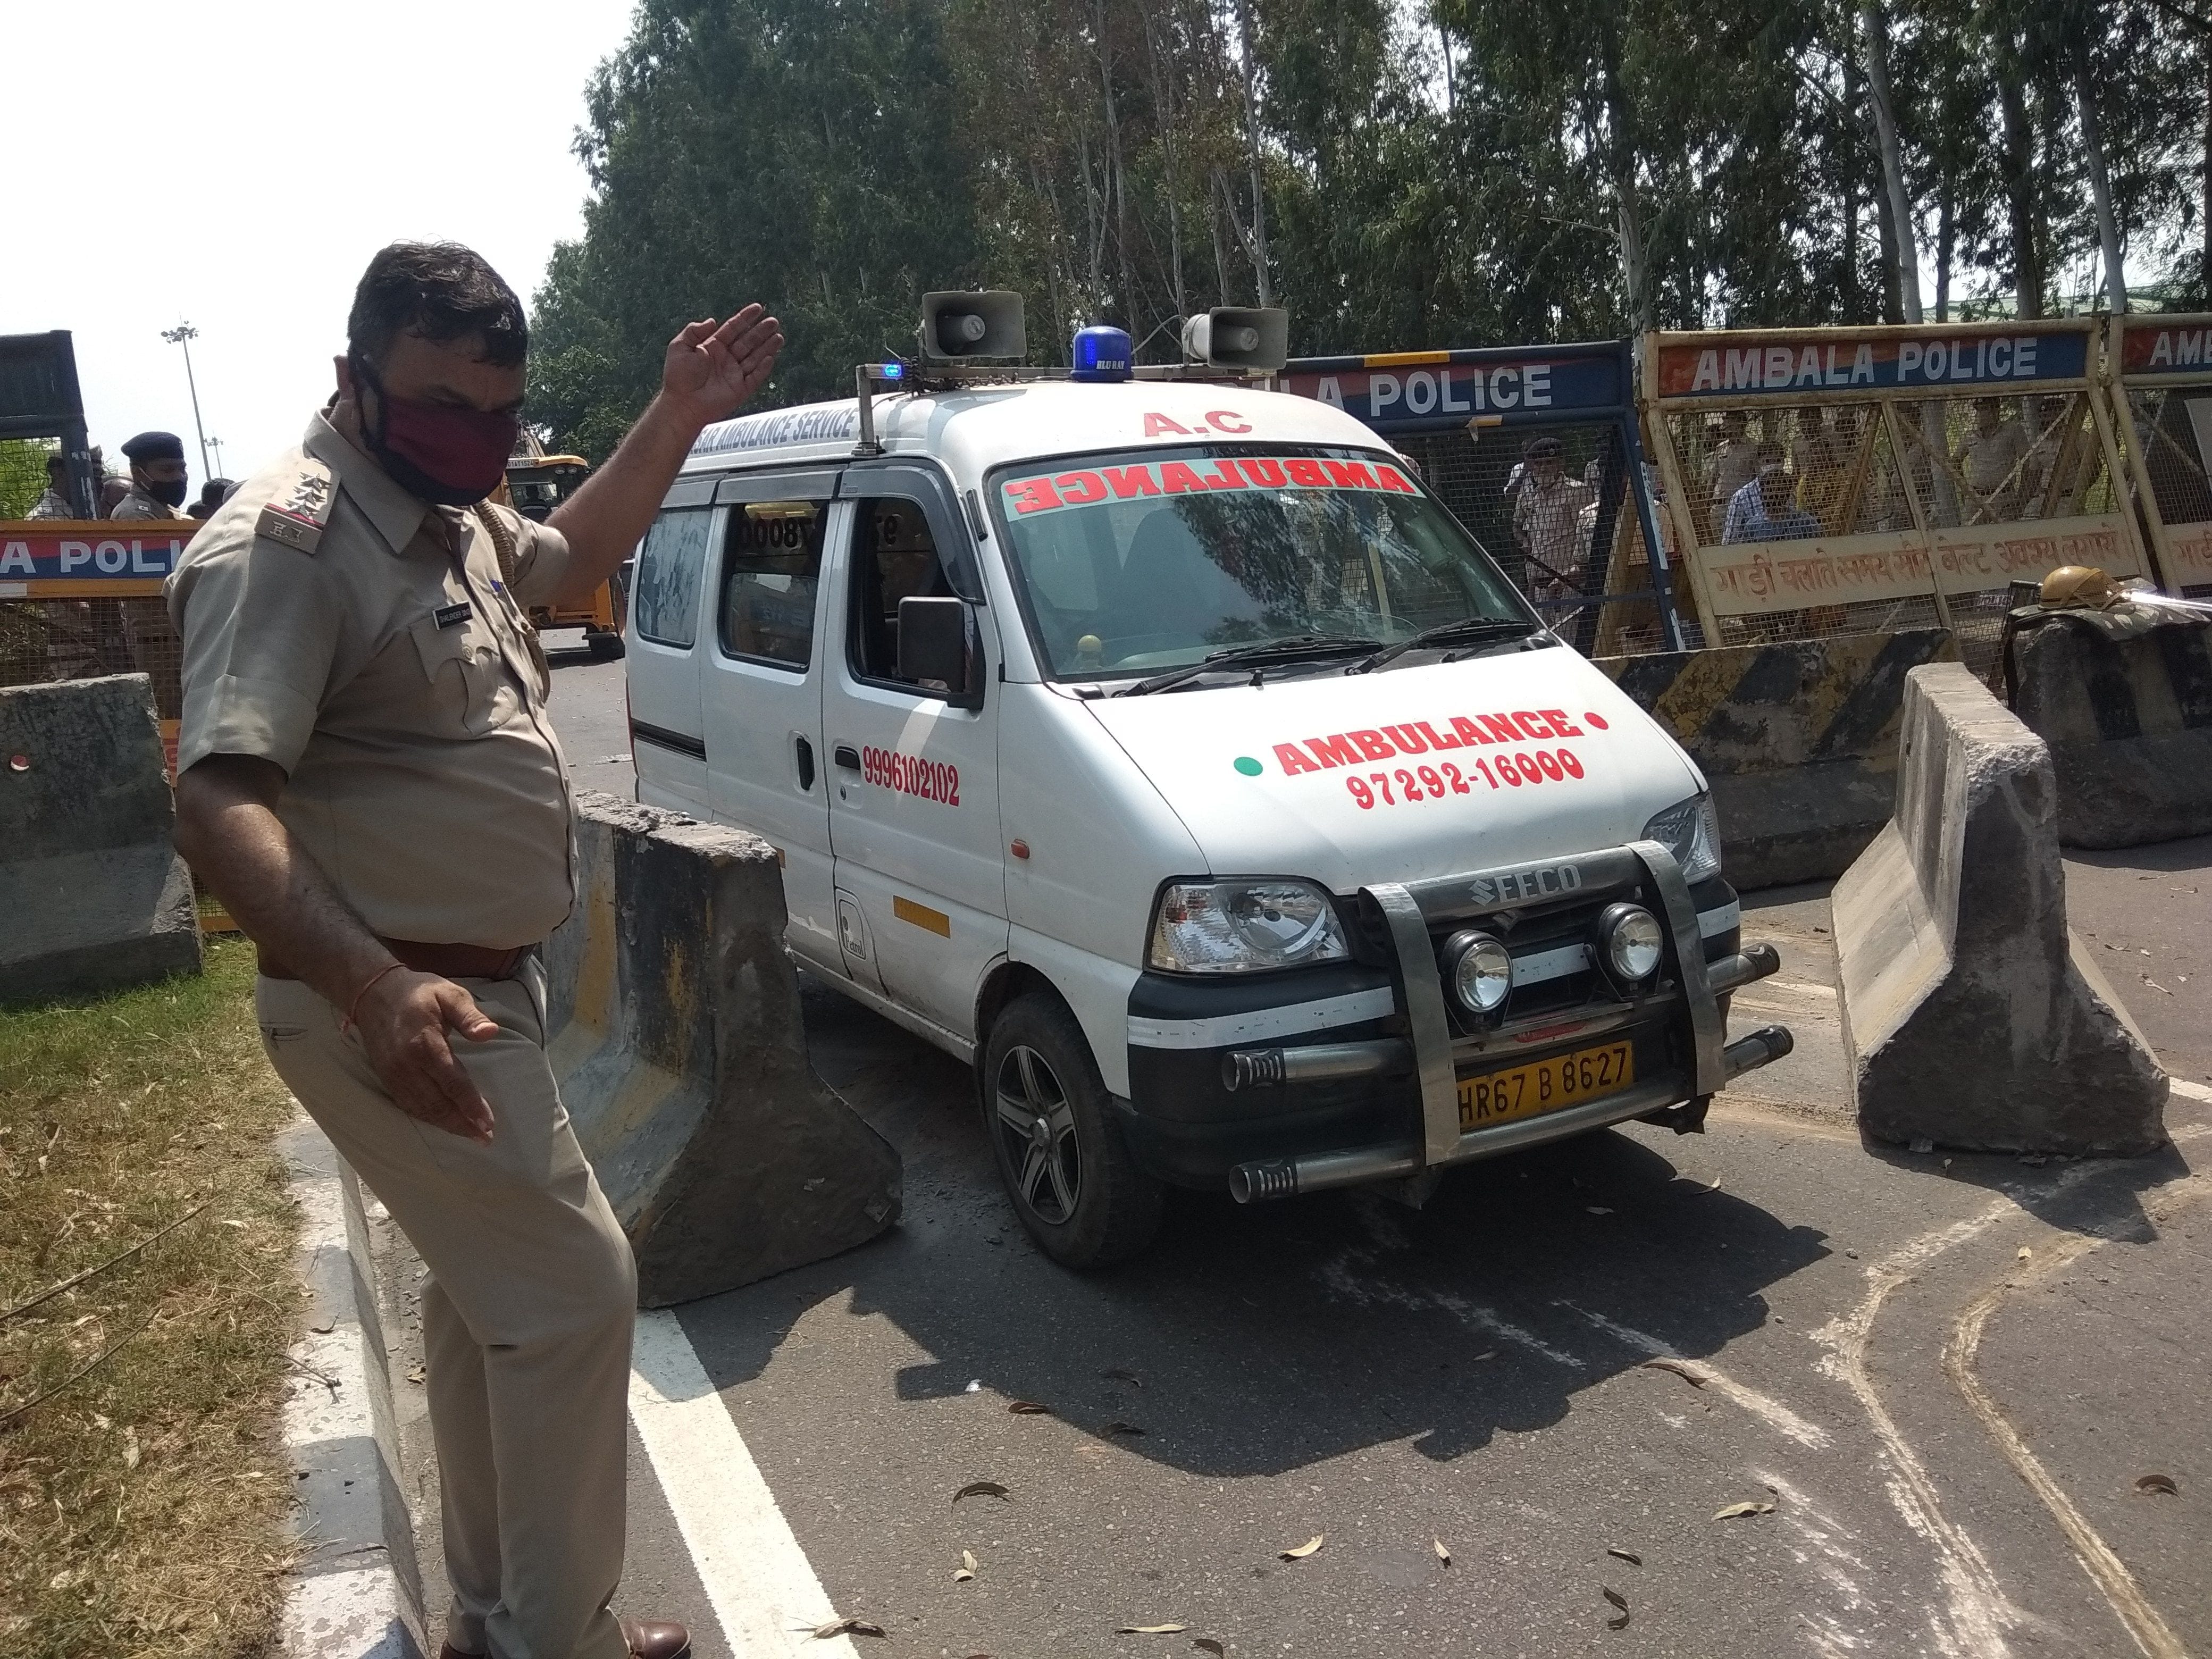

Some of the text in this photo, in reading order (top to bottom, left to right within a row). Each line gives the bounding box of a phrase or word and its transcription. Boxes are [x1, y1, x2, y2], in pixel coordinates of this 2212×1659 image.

[1691, 337, 2037, 391] AMBALA POLICE
[1369, 365, 1552, 417] POLICE
[690, 407, 859, 455] SAR AMBULANCE SERVICE
[1144, 410, 1253, 437] A.C
[60, 540, 181, 573] POLI
[1272, 709, 1585, 776] AMBULANCE
[862, 745, 959, 807] 9996102102
[1346, 748, 1585, 809] 97292-16000
[1494, 865, 1582, 903] EECO
[844, 932, 864, 956] Petrol
[1457, 1047, 1626, 1123] HR67 B 8627
